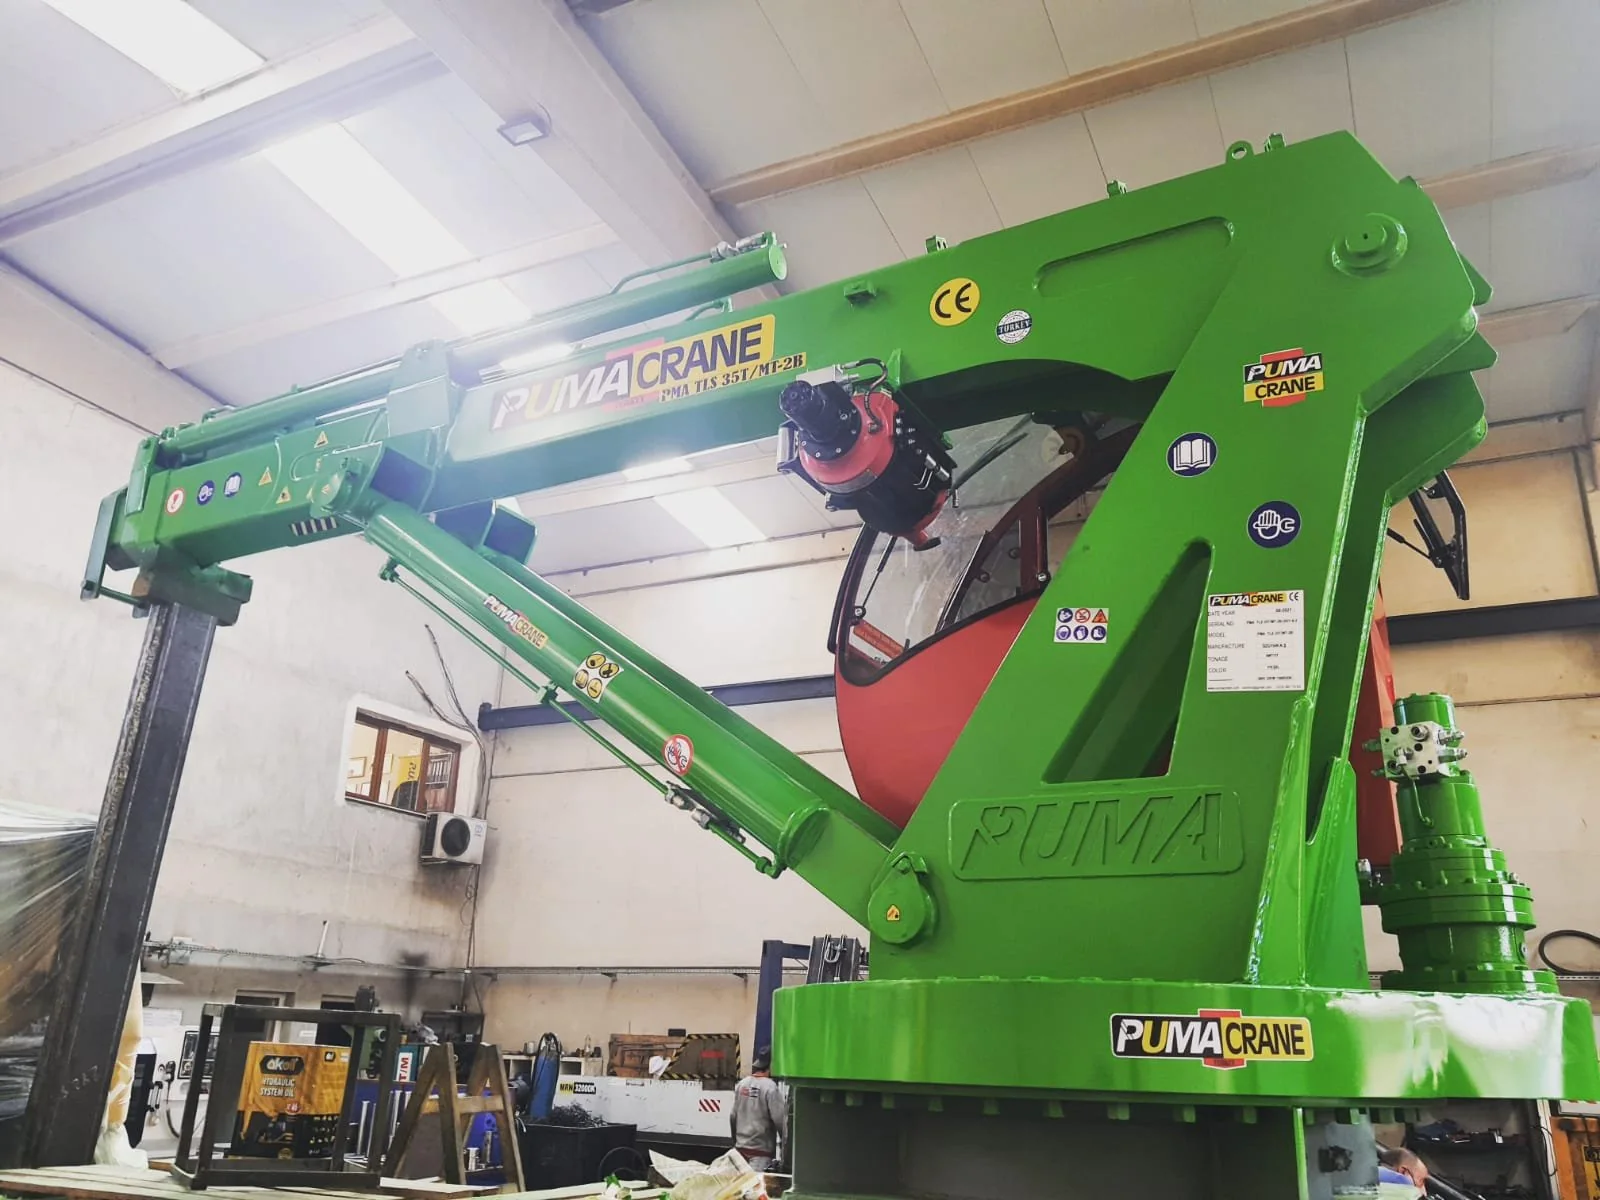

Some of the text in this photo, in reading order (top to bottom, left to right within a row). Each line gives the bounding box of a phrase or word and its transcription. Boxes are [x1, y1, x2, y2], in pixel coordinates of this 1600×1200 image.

[935, 283, 971, 318] CE
[999, 320, 1030, 334] TURKEY
[1247, 356, 1321, 382] PUMA
[660, 386, 690, 402] PMA
[694, 376, 717, 396] TLS
[1255, 376, 1315, 398] CRANE
[961, 793, 1222, 870] PUMA
[260, 1088, 294, 1097] SYSTEM OIL
[263, 1078, 295, 1086] HYDRAULIC
